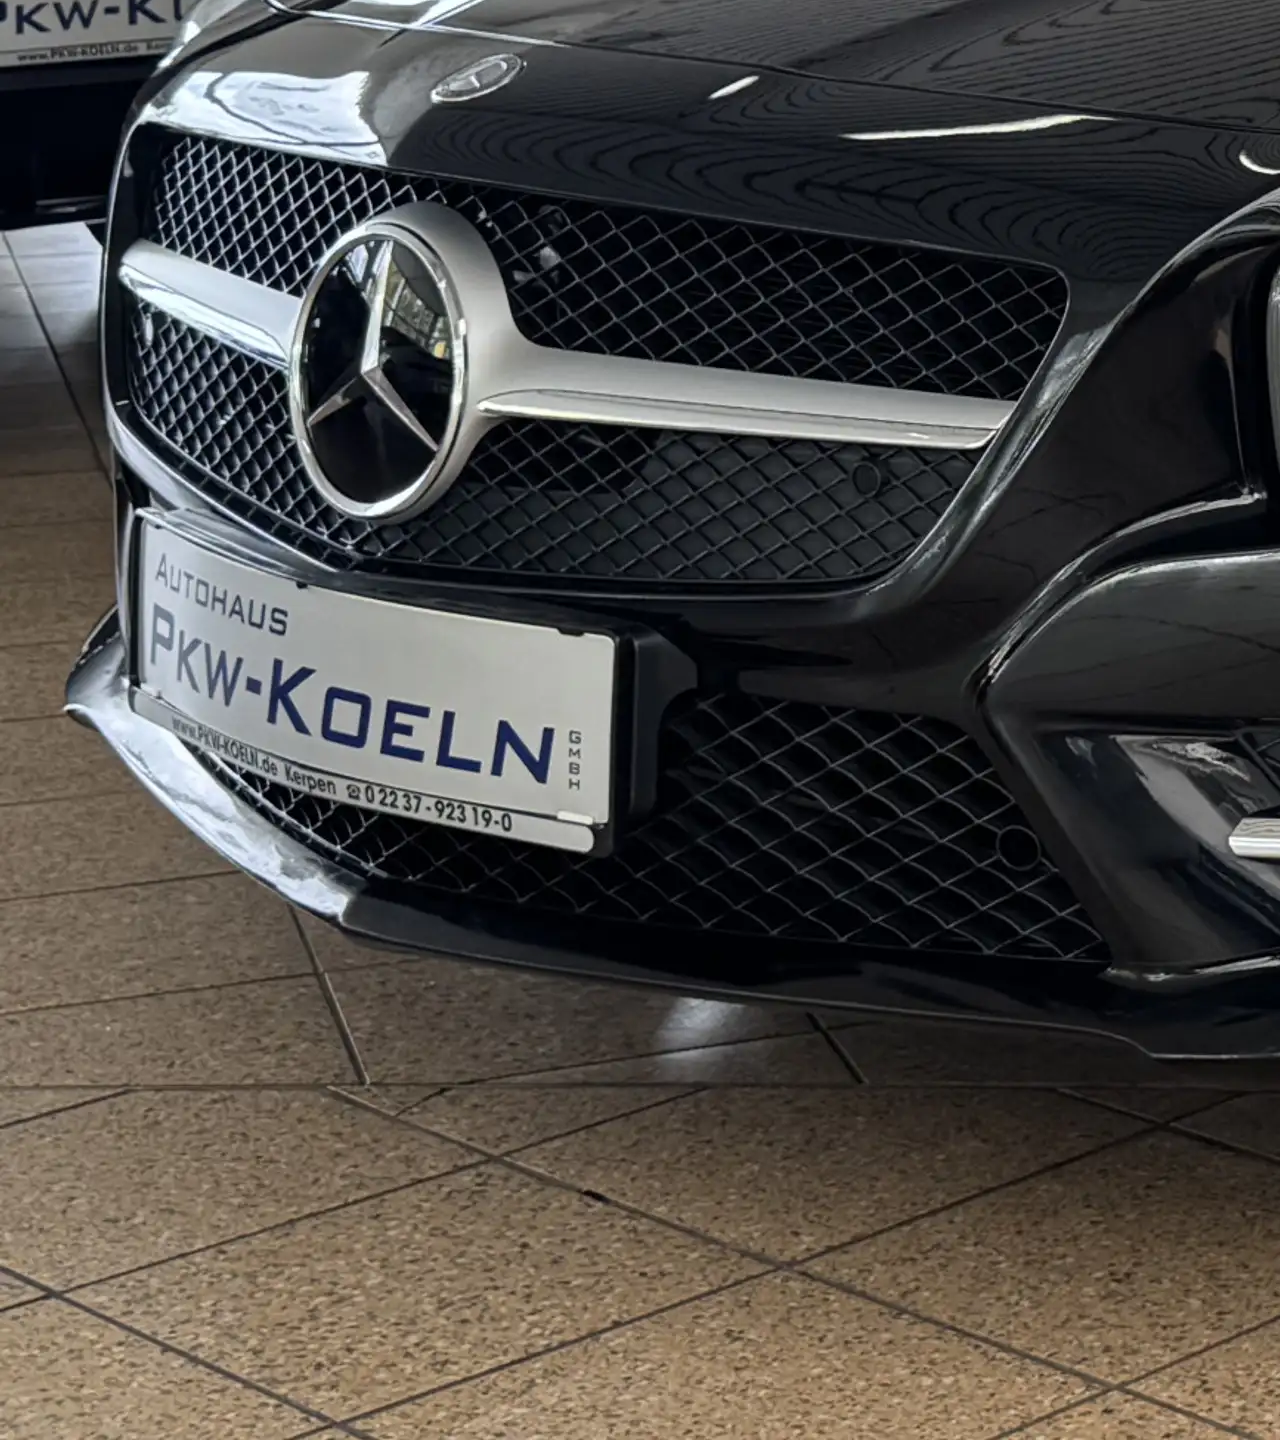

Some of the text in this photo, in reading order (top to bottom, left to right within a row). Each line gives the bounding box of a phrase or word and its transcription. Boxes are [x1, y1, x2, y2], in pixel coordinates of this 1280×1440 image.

[155, 553, 289, 636] AUTOHAUS
[150, 602, 555, 785] PKW-KOELN
[171, 716, 278, 777] www.PKW-KOELN.de
[284, 762, 337, 795] Kerpen
